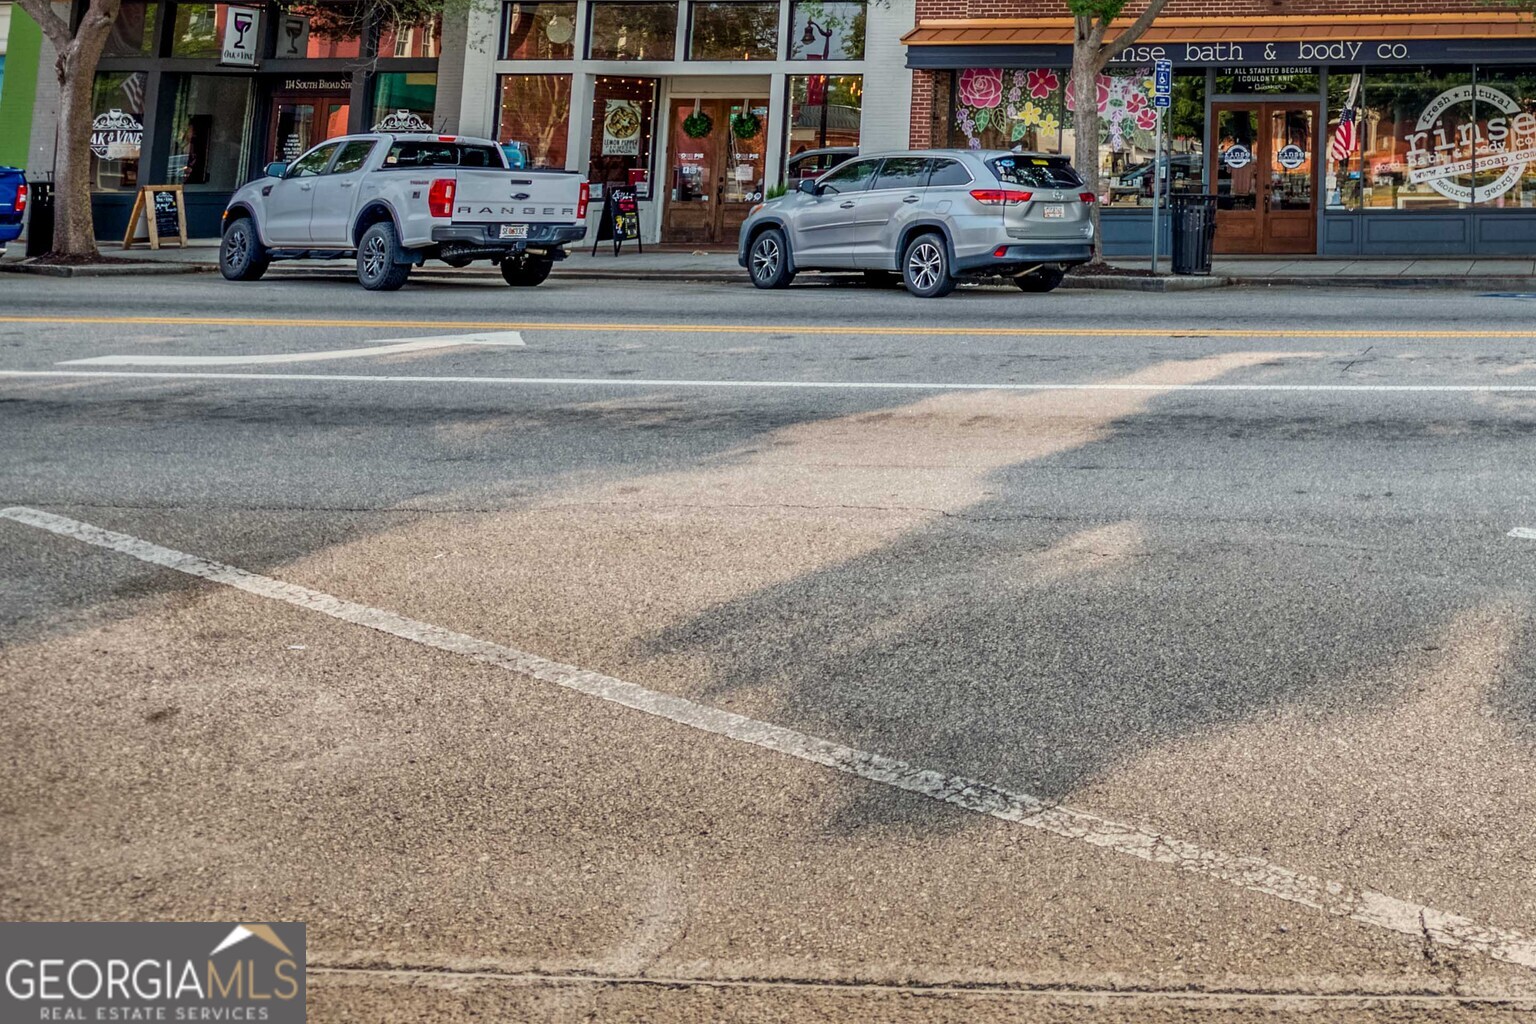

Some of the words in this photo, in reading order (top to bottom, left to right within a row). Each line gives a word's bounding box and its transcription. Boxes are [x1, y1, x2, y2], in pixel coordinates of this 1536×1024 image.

[1184, 42, 1243, 61] bath
[1264, 43, 1277, 60] &
[1298, 41, 1362, 61] body
[1377, 43, 1410, 59] co.
[285, 80, 295, 89] 114
[1422, 96, 1451, 124] fresh
[1463, 89, 1512, 111] natural
[90, 132, 107, 146] AK
[107, 132, 114, 142] &
[116, 130, 143, 145] VINE
[1483, 165, 1520, 199] georgia
[457, 207, 574, 215] RANGER
